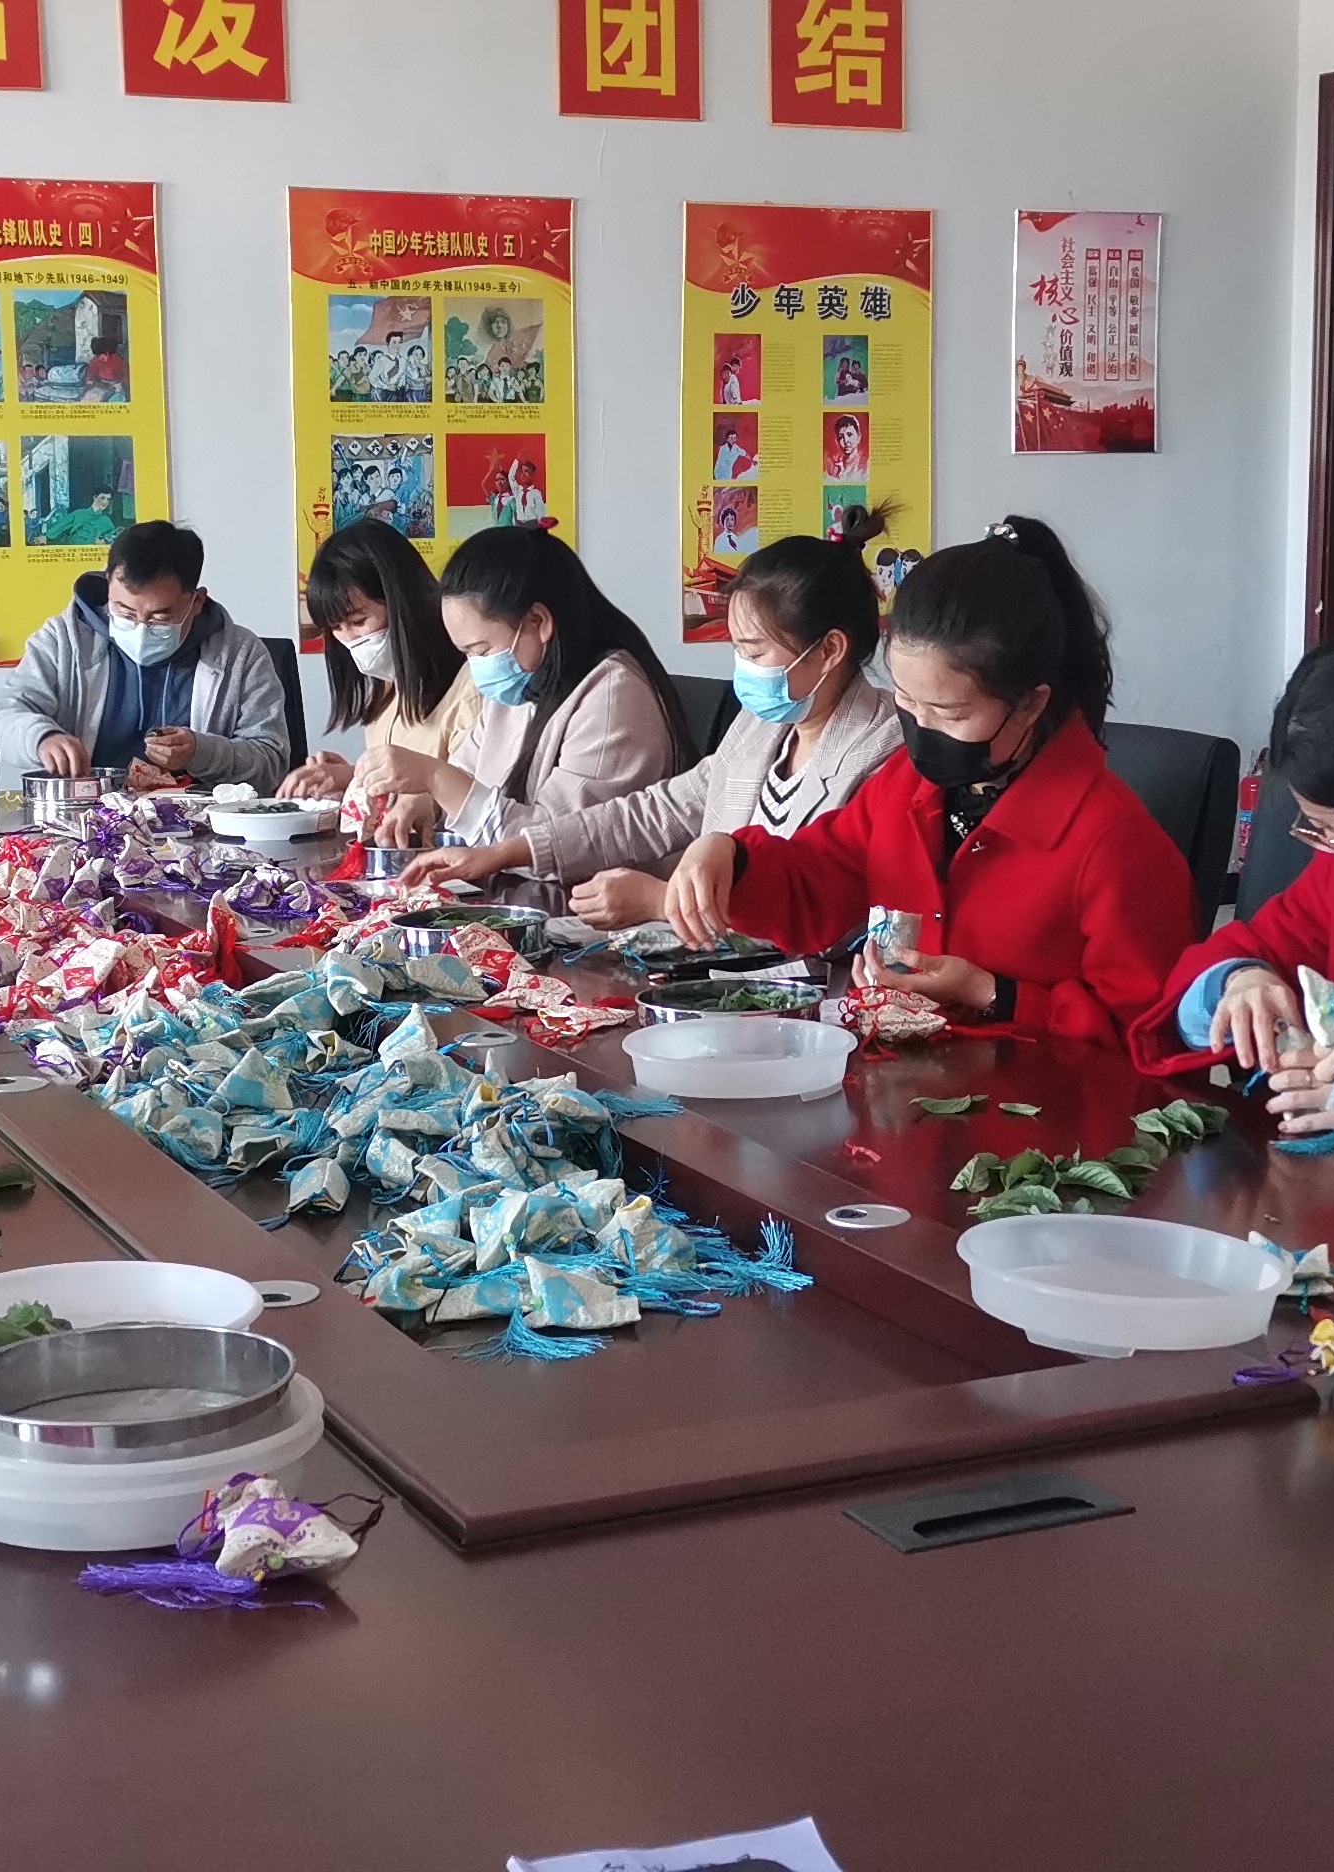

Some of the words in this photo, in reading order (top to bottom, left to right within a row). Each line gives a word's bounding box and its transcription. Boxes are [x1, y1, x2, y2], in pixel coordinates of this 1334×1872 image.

[586, 0, 676, 96] 团
[794, 0, 889, 105] 结
[369, 229, 524, 260] 中国少年先锋队队史（五）
[1059, 236, 1076, 302] 社会主义
[730, 282, 893, 321] 少年英雄
[1058, 328, 1075, 378] 价值观
